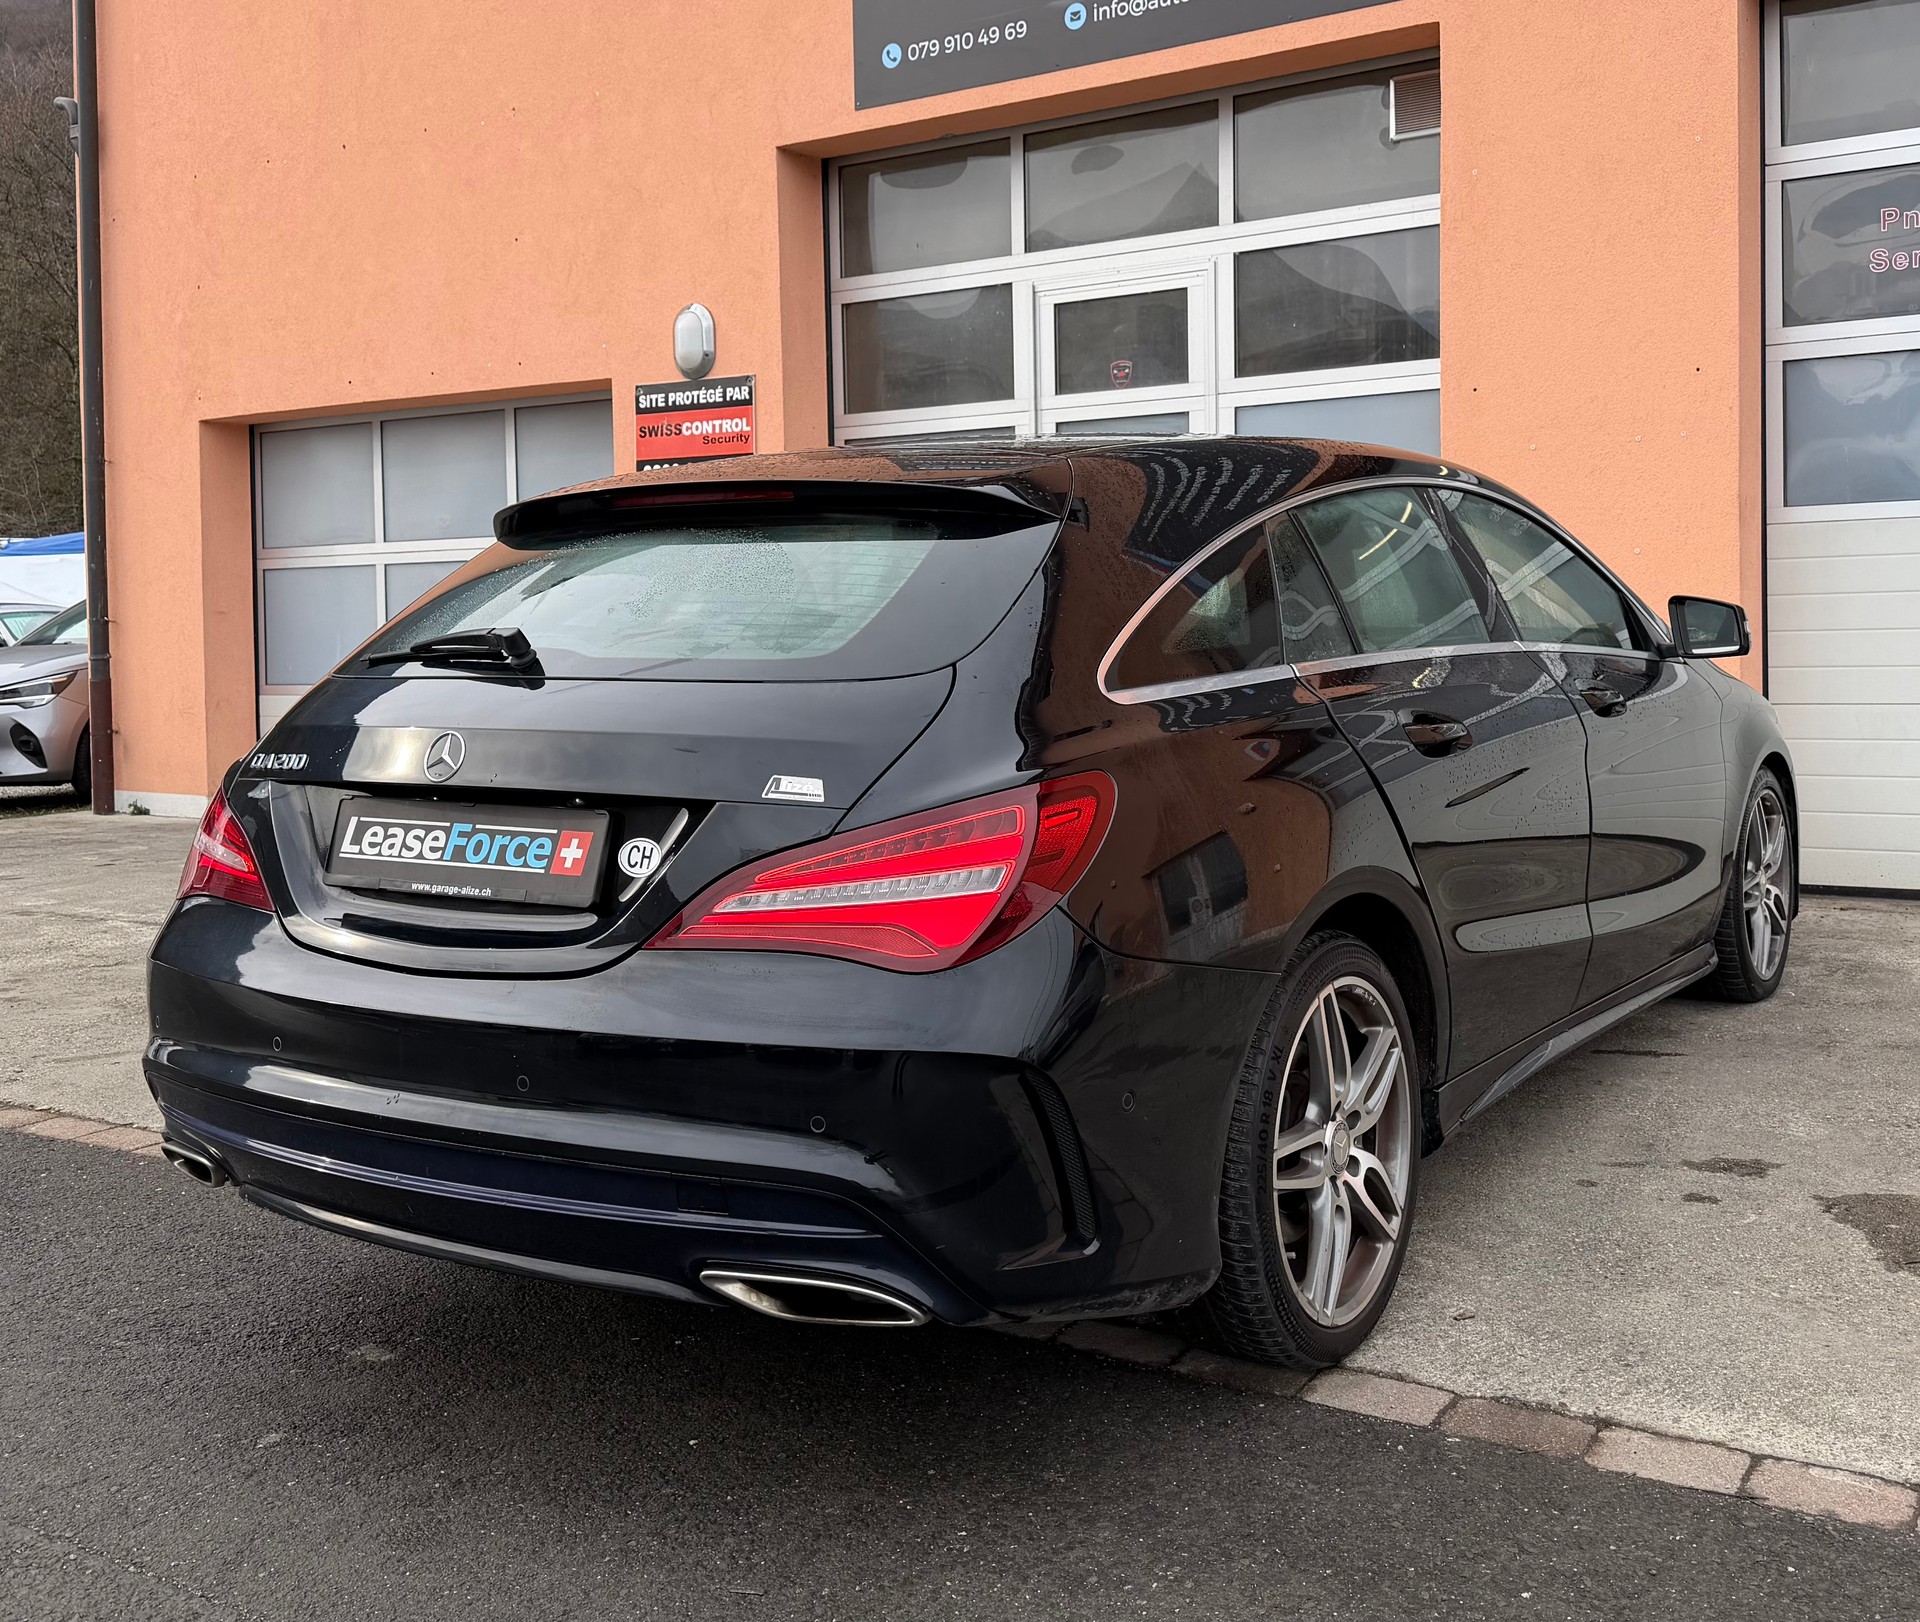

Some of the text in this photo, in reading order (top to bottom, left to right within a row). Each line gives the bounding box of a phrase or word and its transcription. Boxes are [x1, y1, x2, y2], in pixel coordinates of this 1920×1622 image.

[907, 20, 1028, 61] 079 910 49 69
[638, 385, 750, 409] SITE PROTÉGÉ PAR
[702, 432, 750, 445] Security
[340, 816, 552, 868] LeaseForce
[627, 844, 654, 870] CH
[411, 882, 492, 897] www.garage-alize.ch
